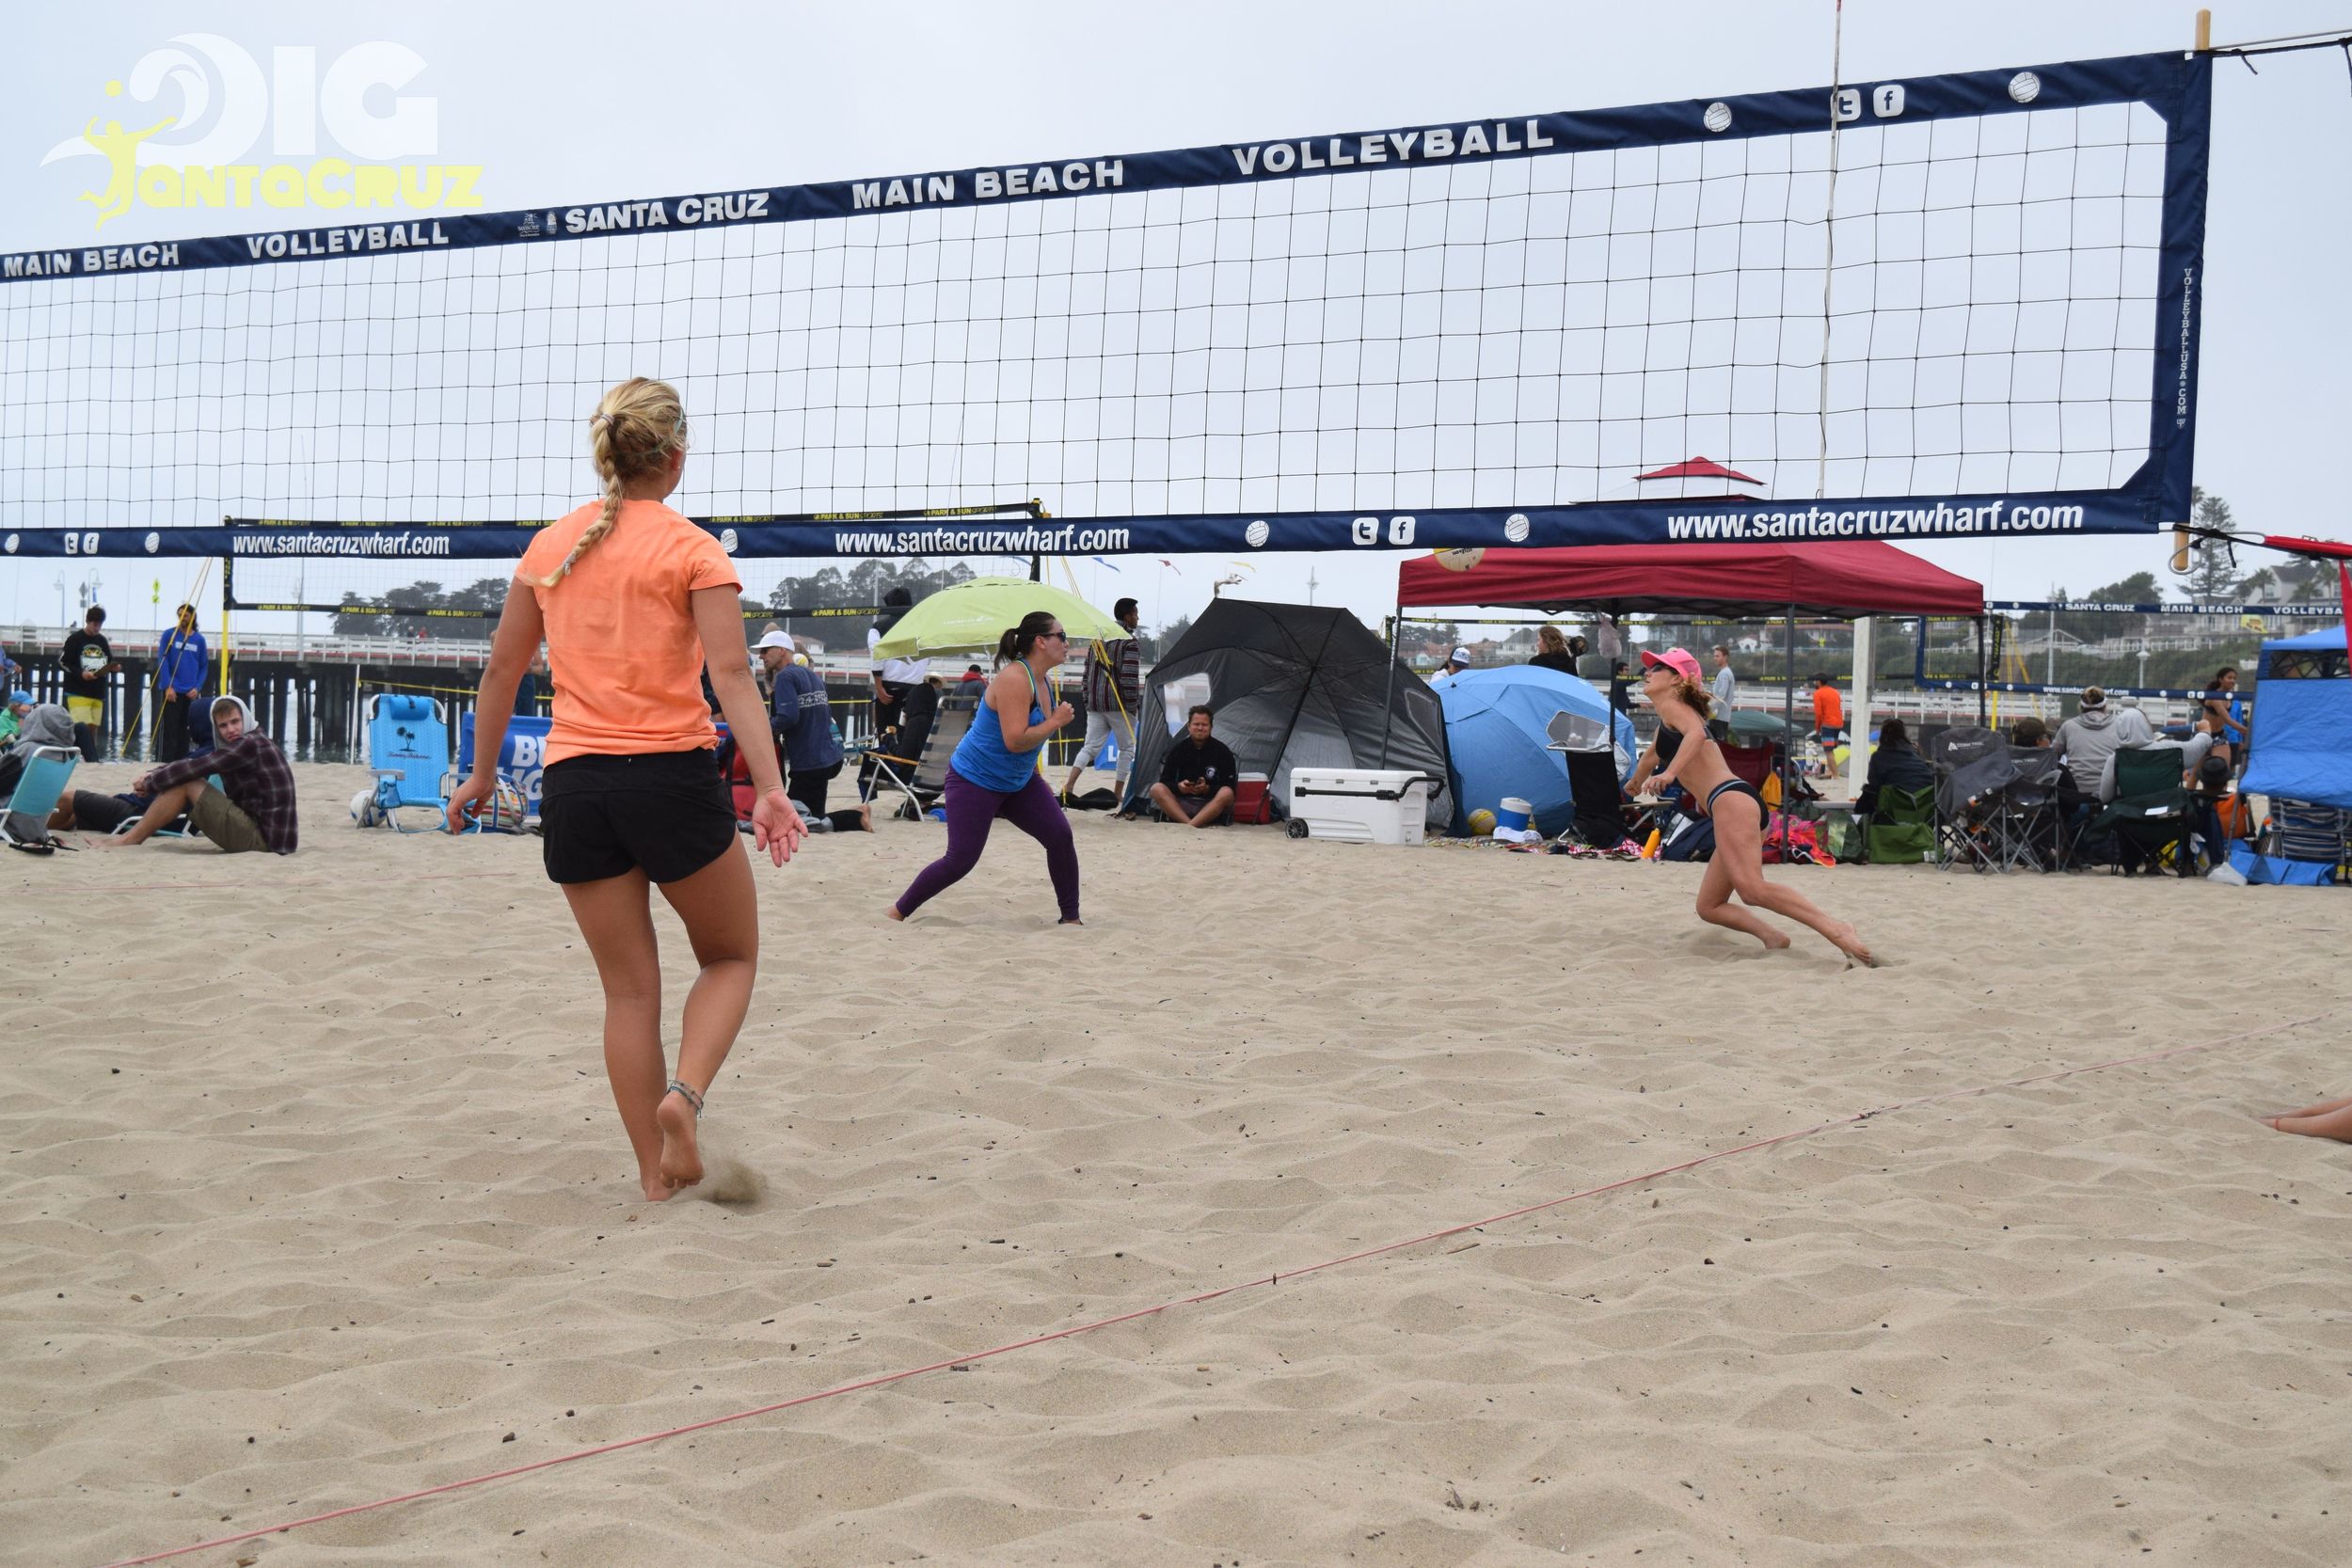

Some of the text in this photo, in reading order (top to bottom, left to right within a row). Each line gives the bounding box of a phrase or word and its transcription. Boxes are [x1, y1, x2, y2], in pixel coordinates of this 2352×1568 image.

[1232, 119, 1554, 175] VOLLEYBALL
[852, 159, 1123, 210] MAIN BEACH
[564, 192, 770, 233] SANTA CRUZ
[246, 221, 449, 259] VOLLEYBALL
[4, 244, 180, 277] MAIN BEACH
[1668, 500, 2084, 540] www.santacruzwharf.com
[233, 531, 450, 555] www.santacruzwharf.com
[835, 524, 1130, 553] www.santacruzwharf.com
[2065, 603, 2136, 612] SANTA CRUZ
[2161, 605, 2244, 614] MAIN BEACH
[2273, 607, 2343, 615] VOLLEYBA
